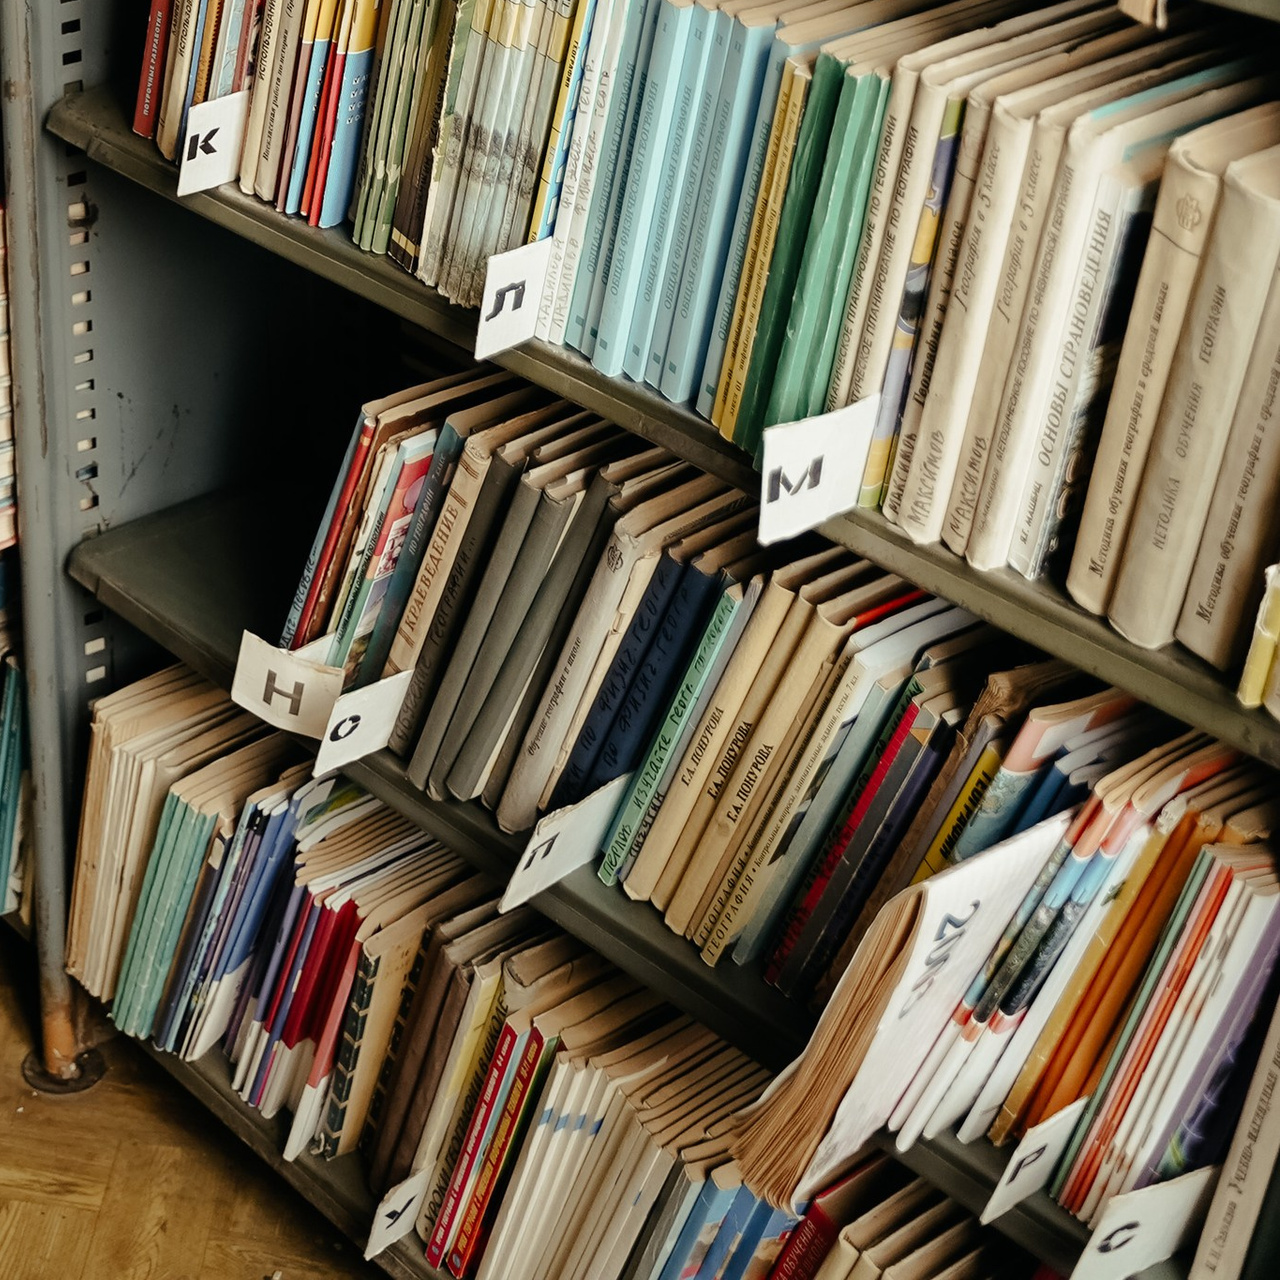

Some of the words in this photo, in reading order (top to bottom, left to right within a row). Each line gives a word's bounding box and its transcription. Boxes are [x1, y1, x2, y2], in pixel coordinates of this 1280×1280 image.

[142, 65, 156, 115] ПОУРОЧНЫЕ
[149, 10, 163, 64] РАЗРАБОТКИ
[186, 127, 220, 162] К
[977, 141, 1000, 192] классе
[642, 253, 660, 303] ОБЩАЯ
[653, 163, 677, 253] ФИЗИЧЕСКАЯ
[669, 84, 692, 164] ГЕОГРАФИЯ
[662, 260, 681, 310] ОБЩАЯ
[673, 171, 698, 261] ФИЗИЧЕСКАЯ
[690, 91, 713, 171] ГЕОГРАФИЯ
[972, 189, 992, 207] 5
[1020, 148, 1044, 201] классе
[969, 210, 988, 221] в
[1011, 220, 1031, 232] в
[952, 224, 983, 312] География
[994, 235, 1025, 323] География
[485, 279, 526, 322] Л
[913, 318, 942, 407] География
[931, 302, 947, 314] в
[941, 219, 963, 279] классе
[1148, 280, 1172, 325] школе
[1036, 380, 1070, 468] ОСНОВЫ
[1059, 206, 1111, 379] СТРАНОВЕДЕНИЯ
[1136, 324, 1161, 378] средней
[1131, 377, 1151, 390] в
[1252, 365, 1278, 422] средней
[1117, 389, 1146, 457] географии
[1152, 477, 1180, 550] МЕТОДИКА
[1174, 380, 1203, 459] ОБУЧЕНИЯ
[1196, 283, 1226, 364] ГЕОГРАФИИ
[1247, 420, 1268, 434] в
[766, 453, 825, 507] М
[1103, 456, 1130, 515] обучения
[1231, 433, 1263, 501] географии
[1089, 515, 1116, 578] Методика
[1214, 500, 1244, 560] обучения
[405, 502, 457, 632] КРАЕВЕДЕНИЕ
[1196, 558, 1228, 625] Методика
[558, 664, 573, 676] в
[563, 634, 584, 667] школе
[262, 668, 306, 717] Н
[542, 672, 568, 720] географии
[527, 716, 550, 758] Обучение
[723, 798, 745, 823] Г.А.
[736, 740, 773, 803] ПОНУРОВА
[705, 871, 752, 957] ГЕОГРАФИЯ
[751, 817, 782, 868] Контрольные
[774, 791, 796, 824] вопросы,
[791, 740, 823, 794] занимательные
[818, 710, 840, 744] задания,
[843, 682, 856, 692] 7
[523, 831, 561, 872] П
[1005, 1142, 1048, 1187] Р
[773, 1218, 824, 1276] ОБУЧЕНИЯ
[1097, 1220, 1140, 1254] С
